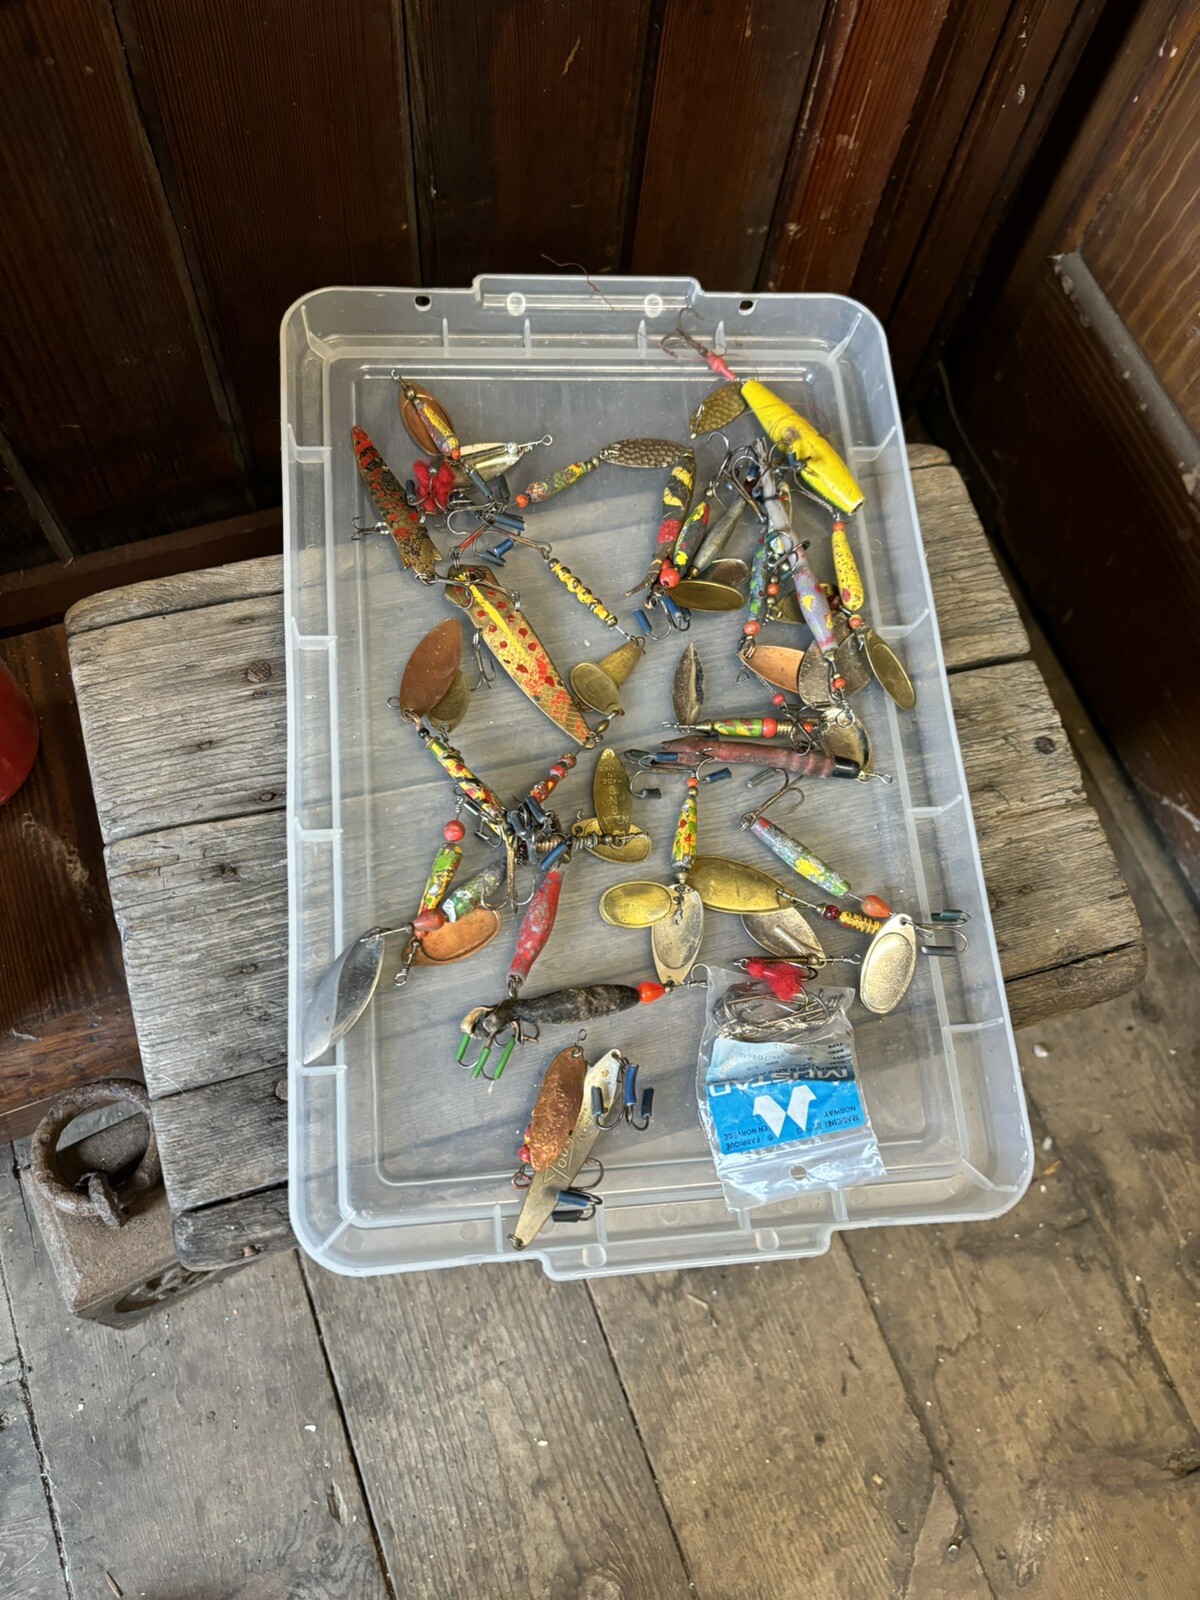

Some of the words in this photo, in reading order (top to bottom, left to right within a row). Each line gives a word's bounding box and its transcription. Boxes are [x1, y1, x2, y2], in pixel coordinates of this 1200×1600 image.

[709, 1068, 848, 1098] MUSTAD
[823, 1104, 857, 1118] NORWAY
[828, 1117, 838, 1128] IN
[838, 1114, 859, 1126] MADE
[757, 1125, 768, 1134] EN
